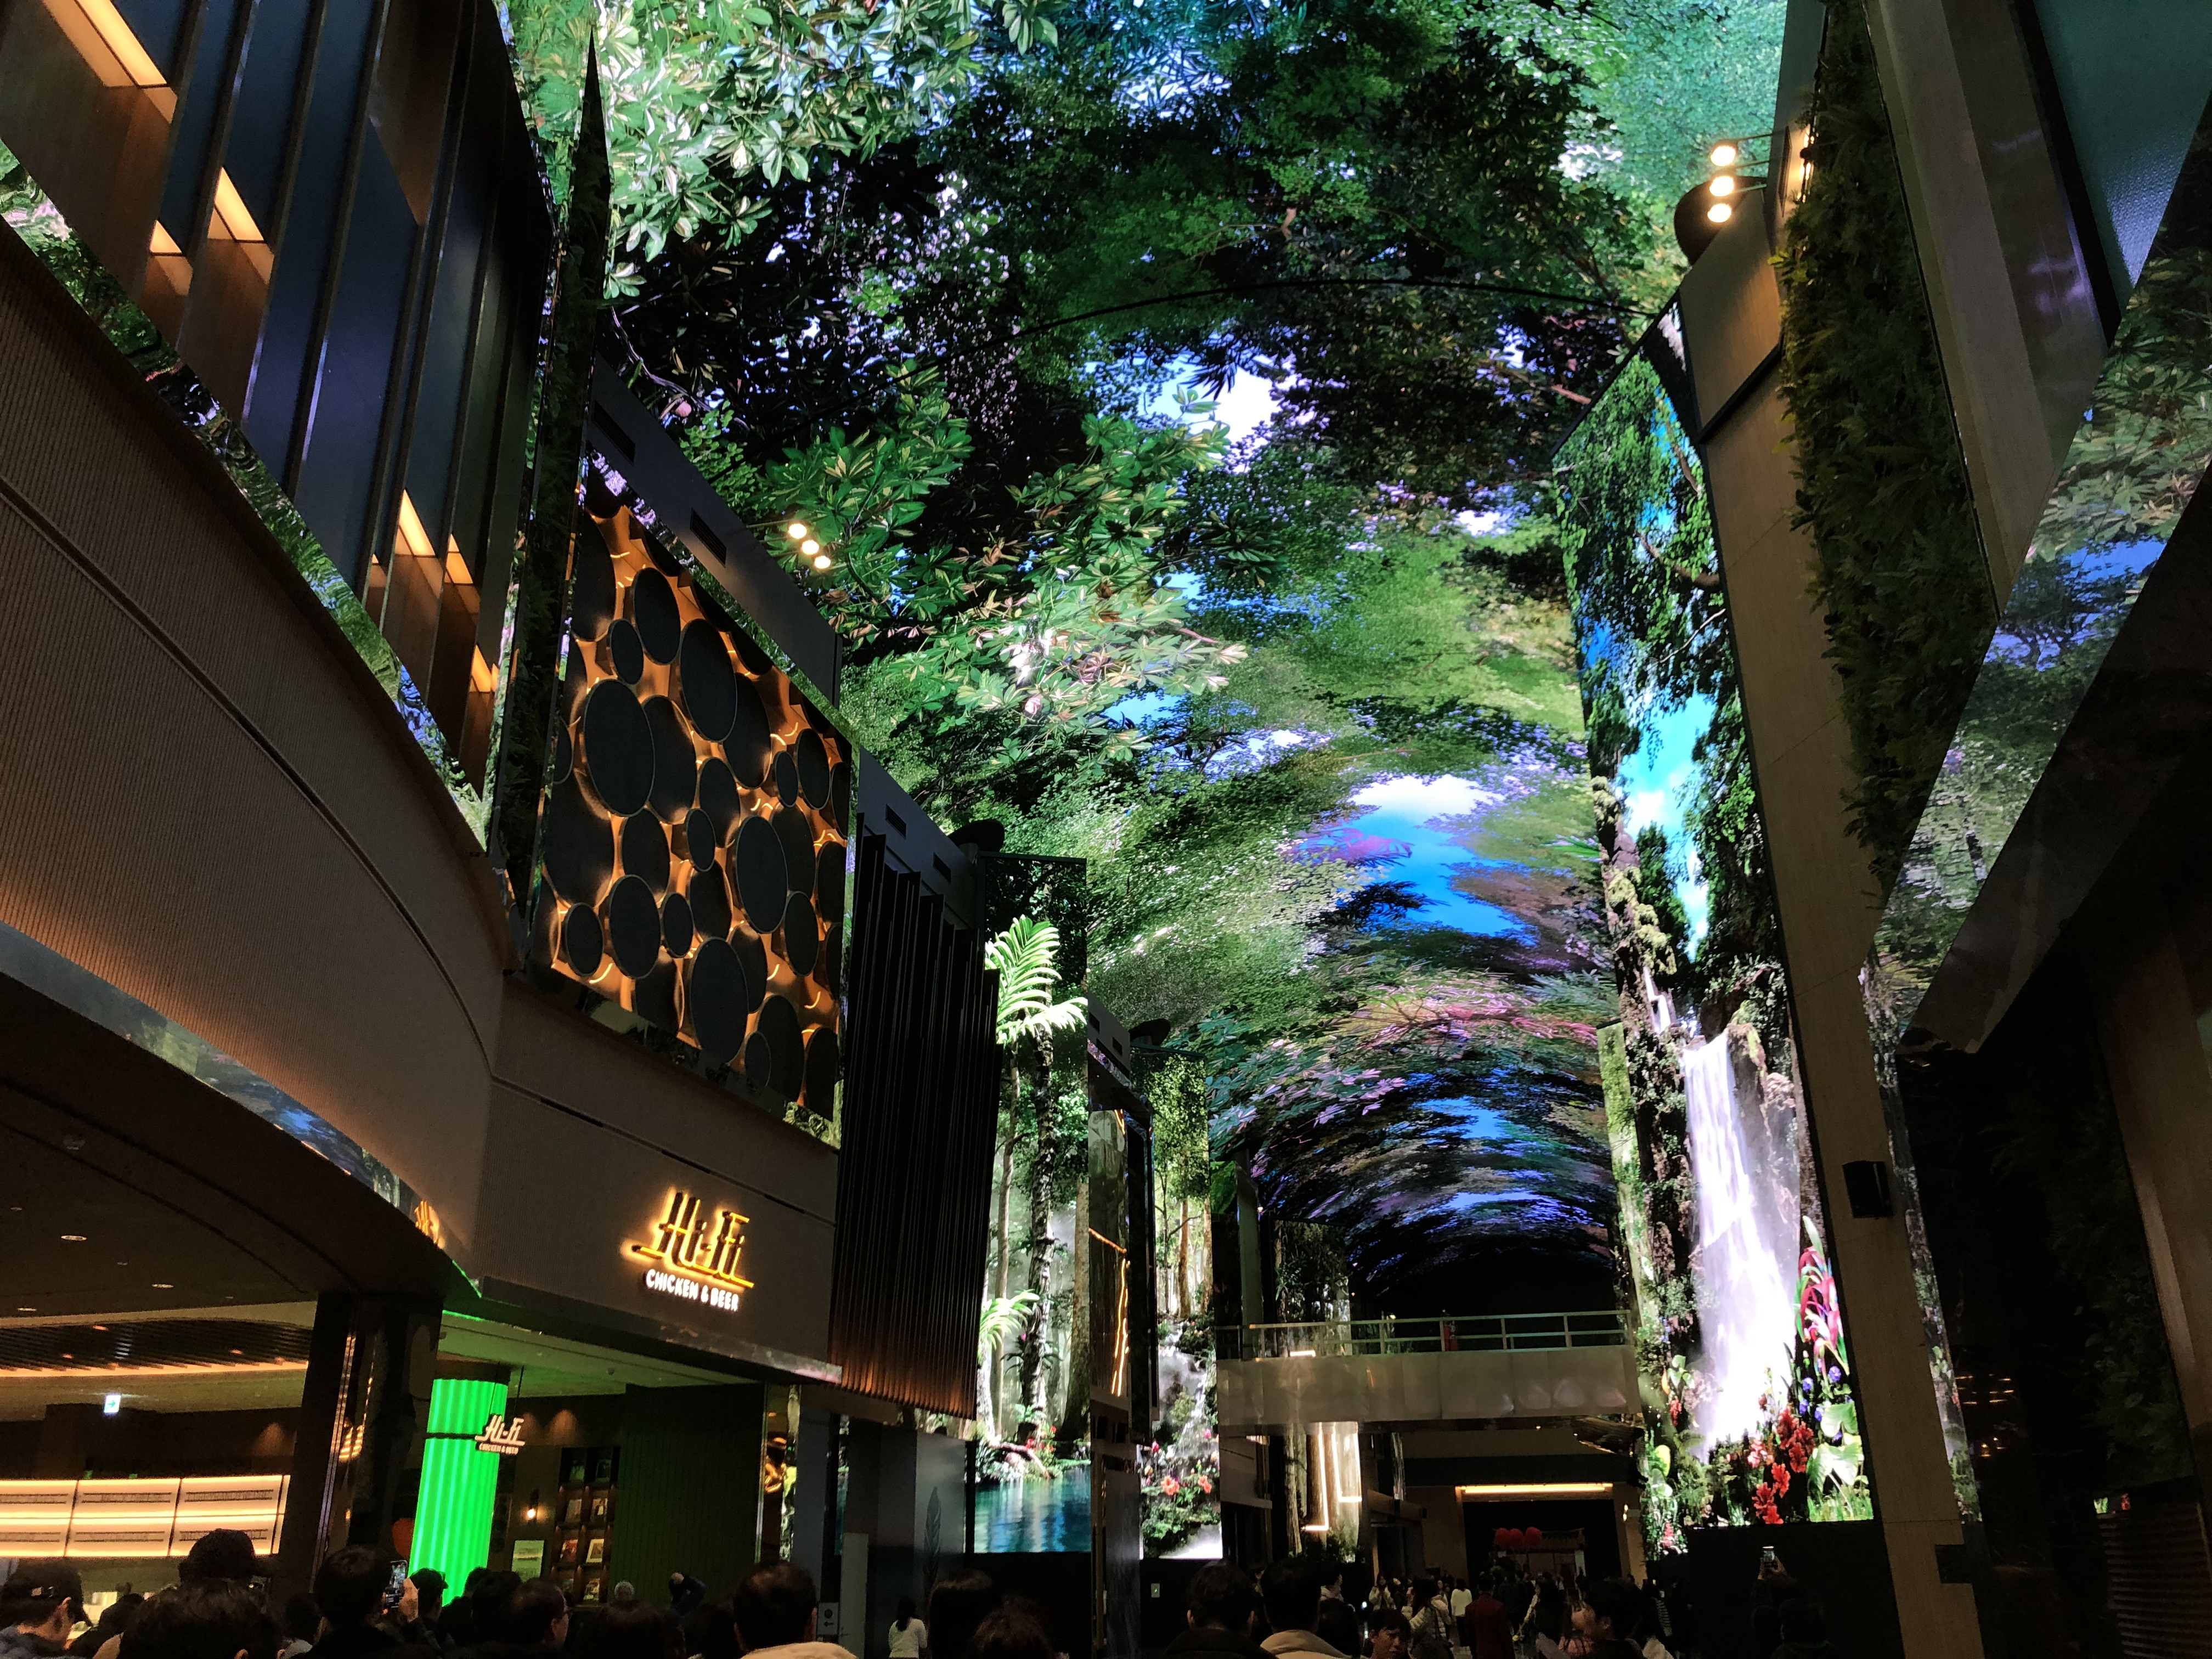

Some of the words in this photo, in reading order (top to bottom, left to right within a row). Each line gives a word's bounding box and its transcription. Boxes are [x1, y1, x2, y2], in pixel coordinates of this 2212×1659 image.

[644, 1268, 699, 1300] CHICKEN
[701, 1285, 709, 1303] &
[710, 1288, 739, 1312] BEER
